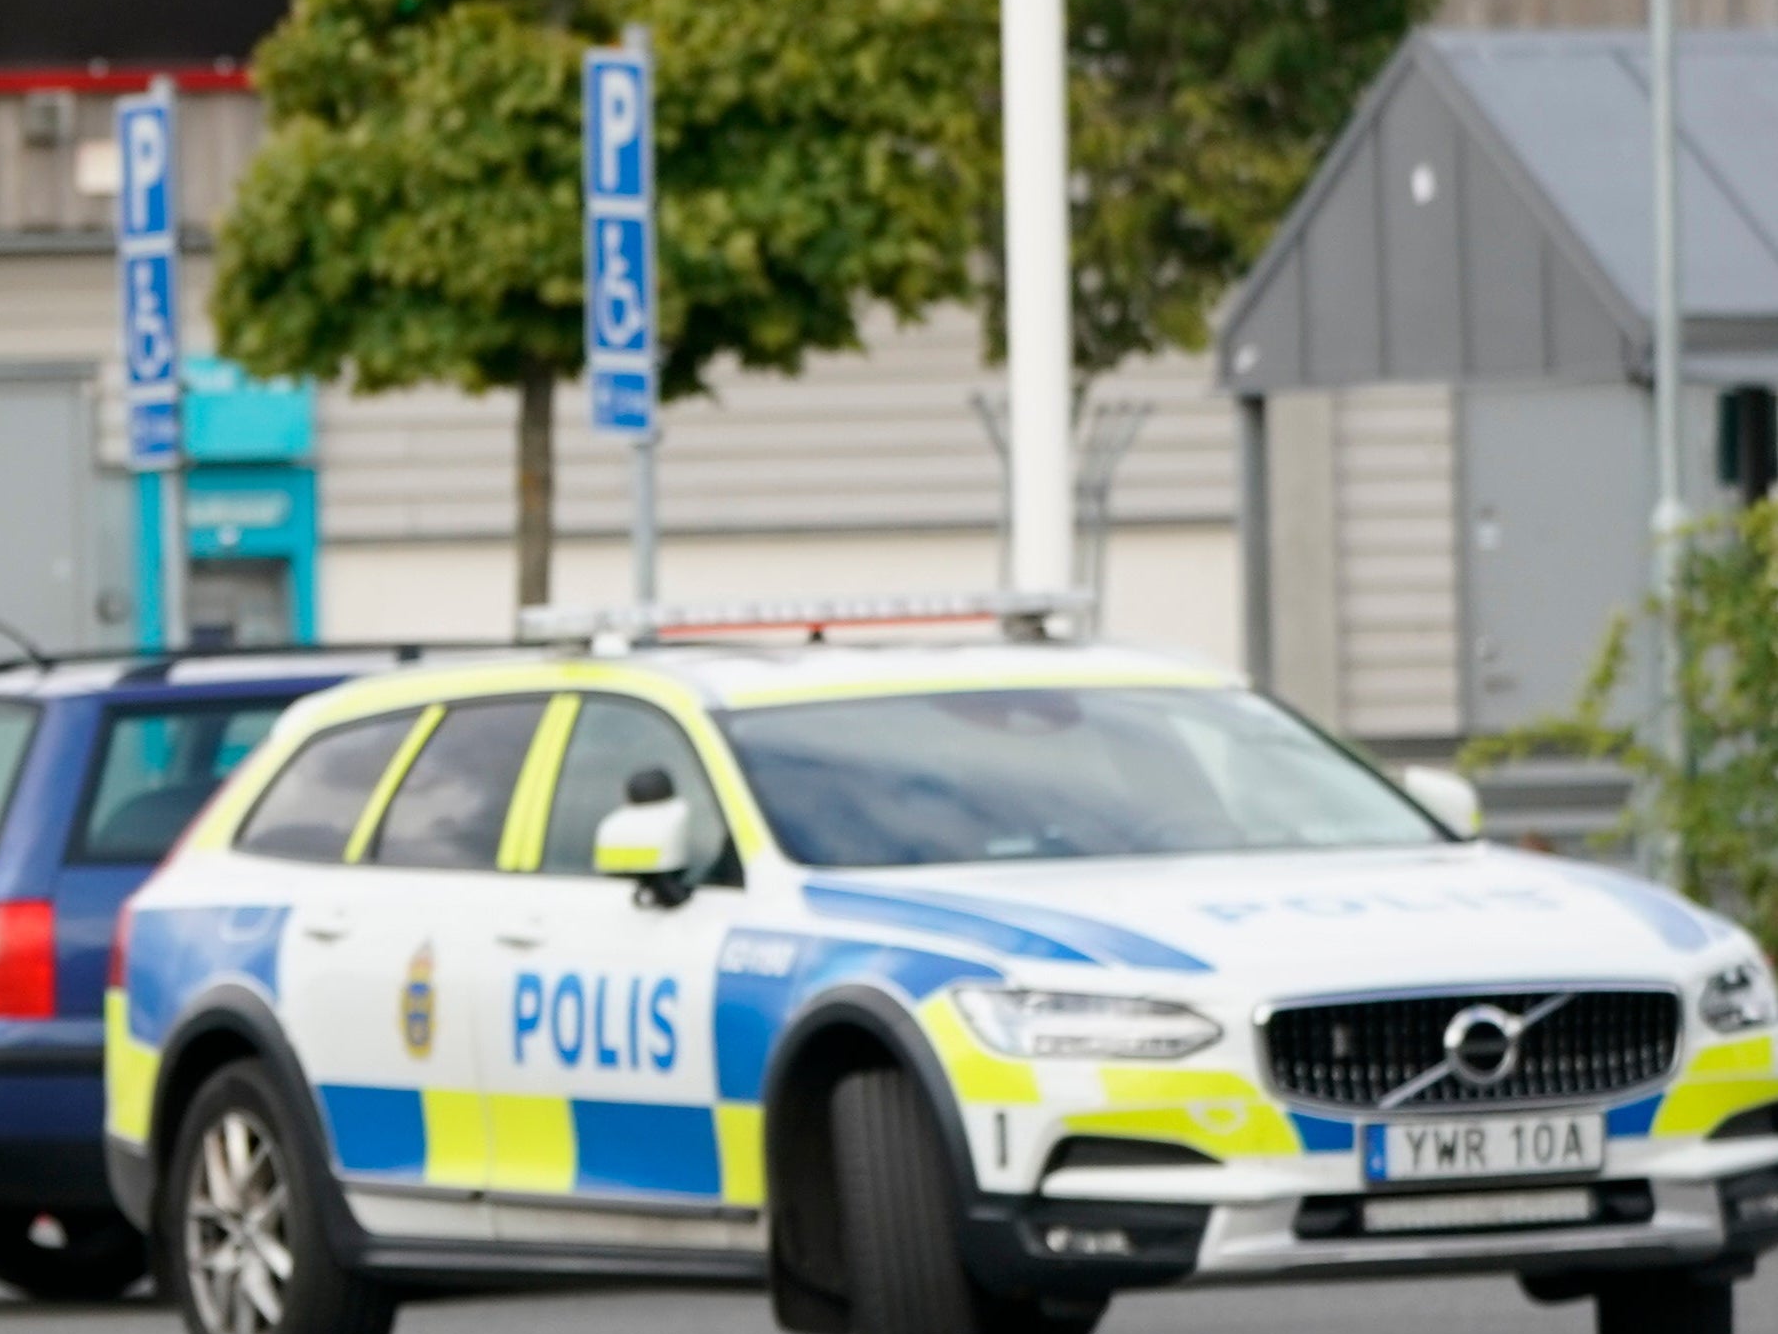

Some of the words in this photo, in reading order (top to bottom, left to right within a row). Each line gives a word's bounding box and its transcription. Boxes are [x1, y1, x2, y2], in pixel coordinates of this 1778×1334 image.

[514, 972, 678, 1074] POLIS
[1405, 1127, 1485, 1169] YWR
[1510, 1123, 1582, 1164] 10A
